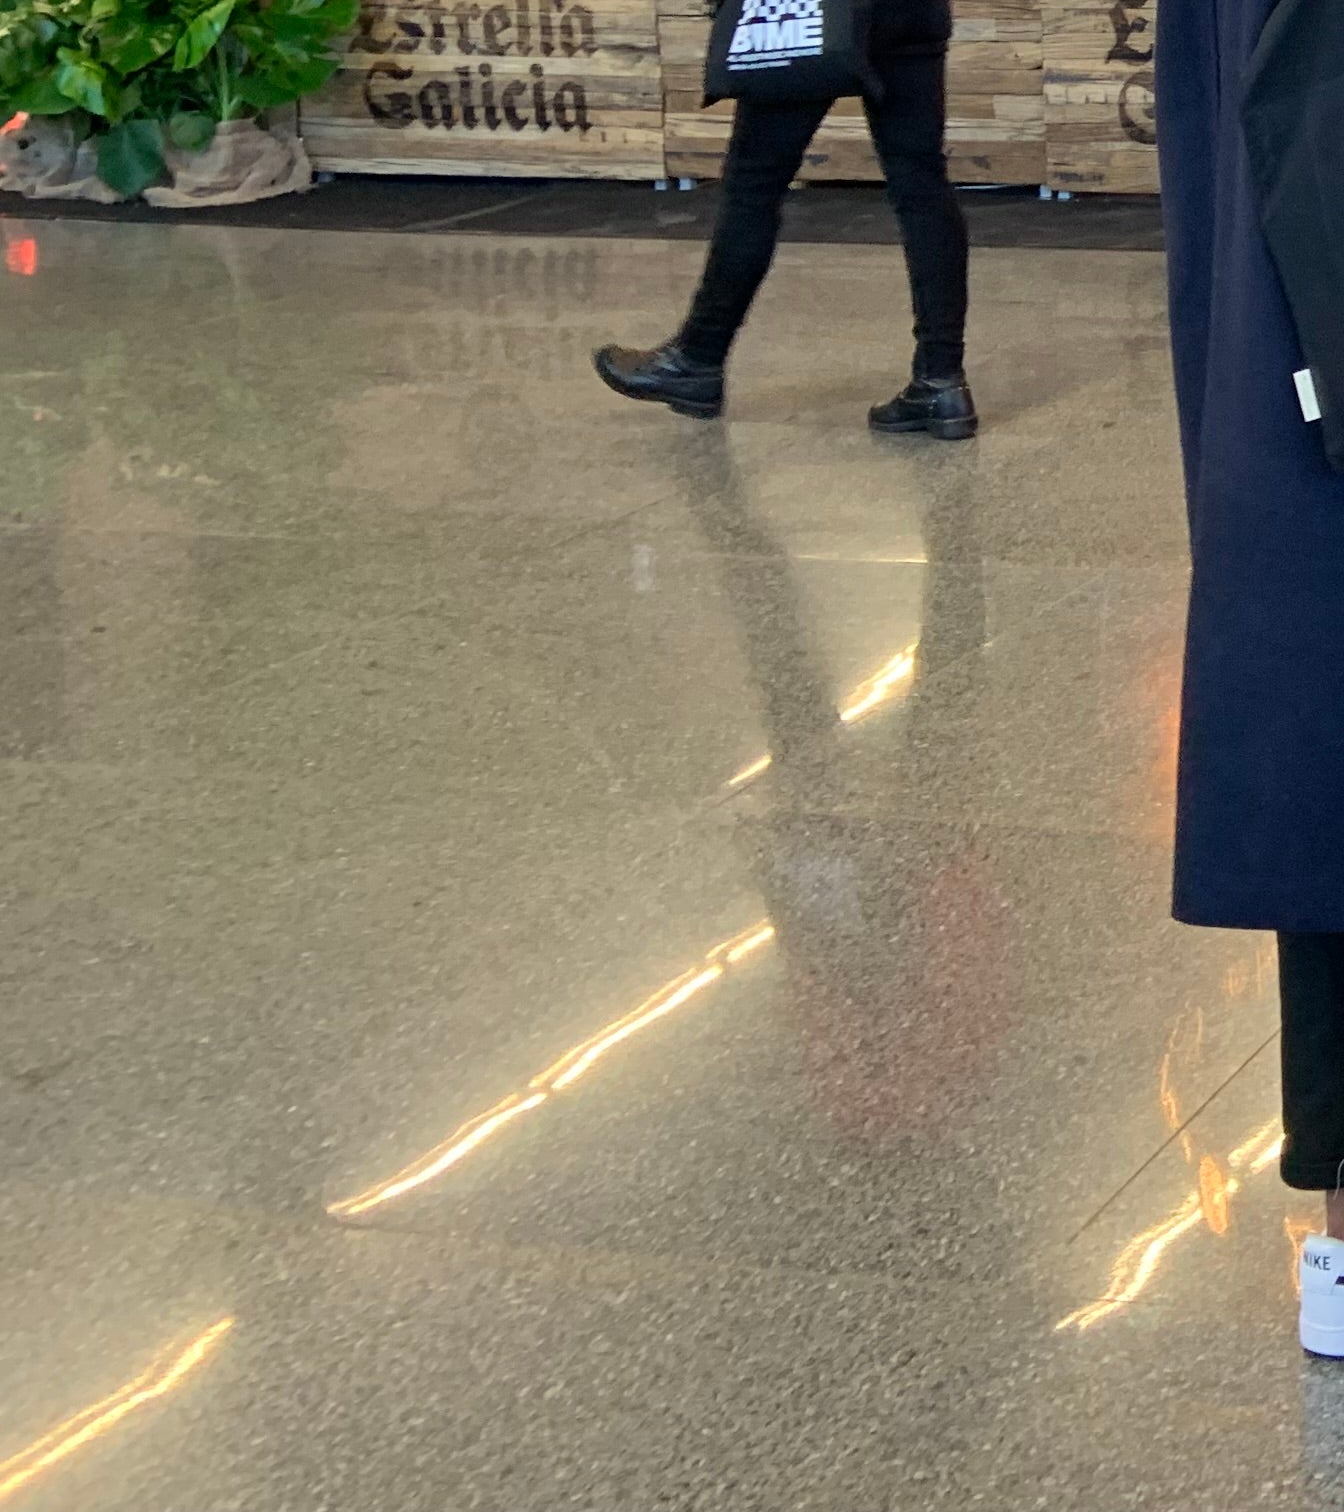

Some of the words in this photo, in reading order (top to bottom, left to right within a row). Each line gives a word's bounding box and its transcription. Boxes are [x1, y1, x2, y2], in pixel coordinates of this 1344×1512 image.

[728, 17, 824, 54] BIME
[363, 61, 594, 134] Galicia
[1302, 1248, 1332, 1271] NIKE
